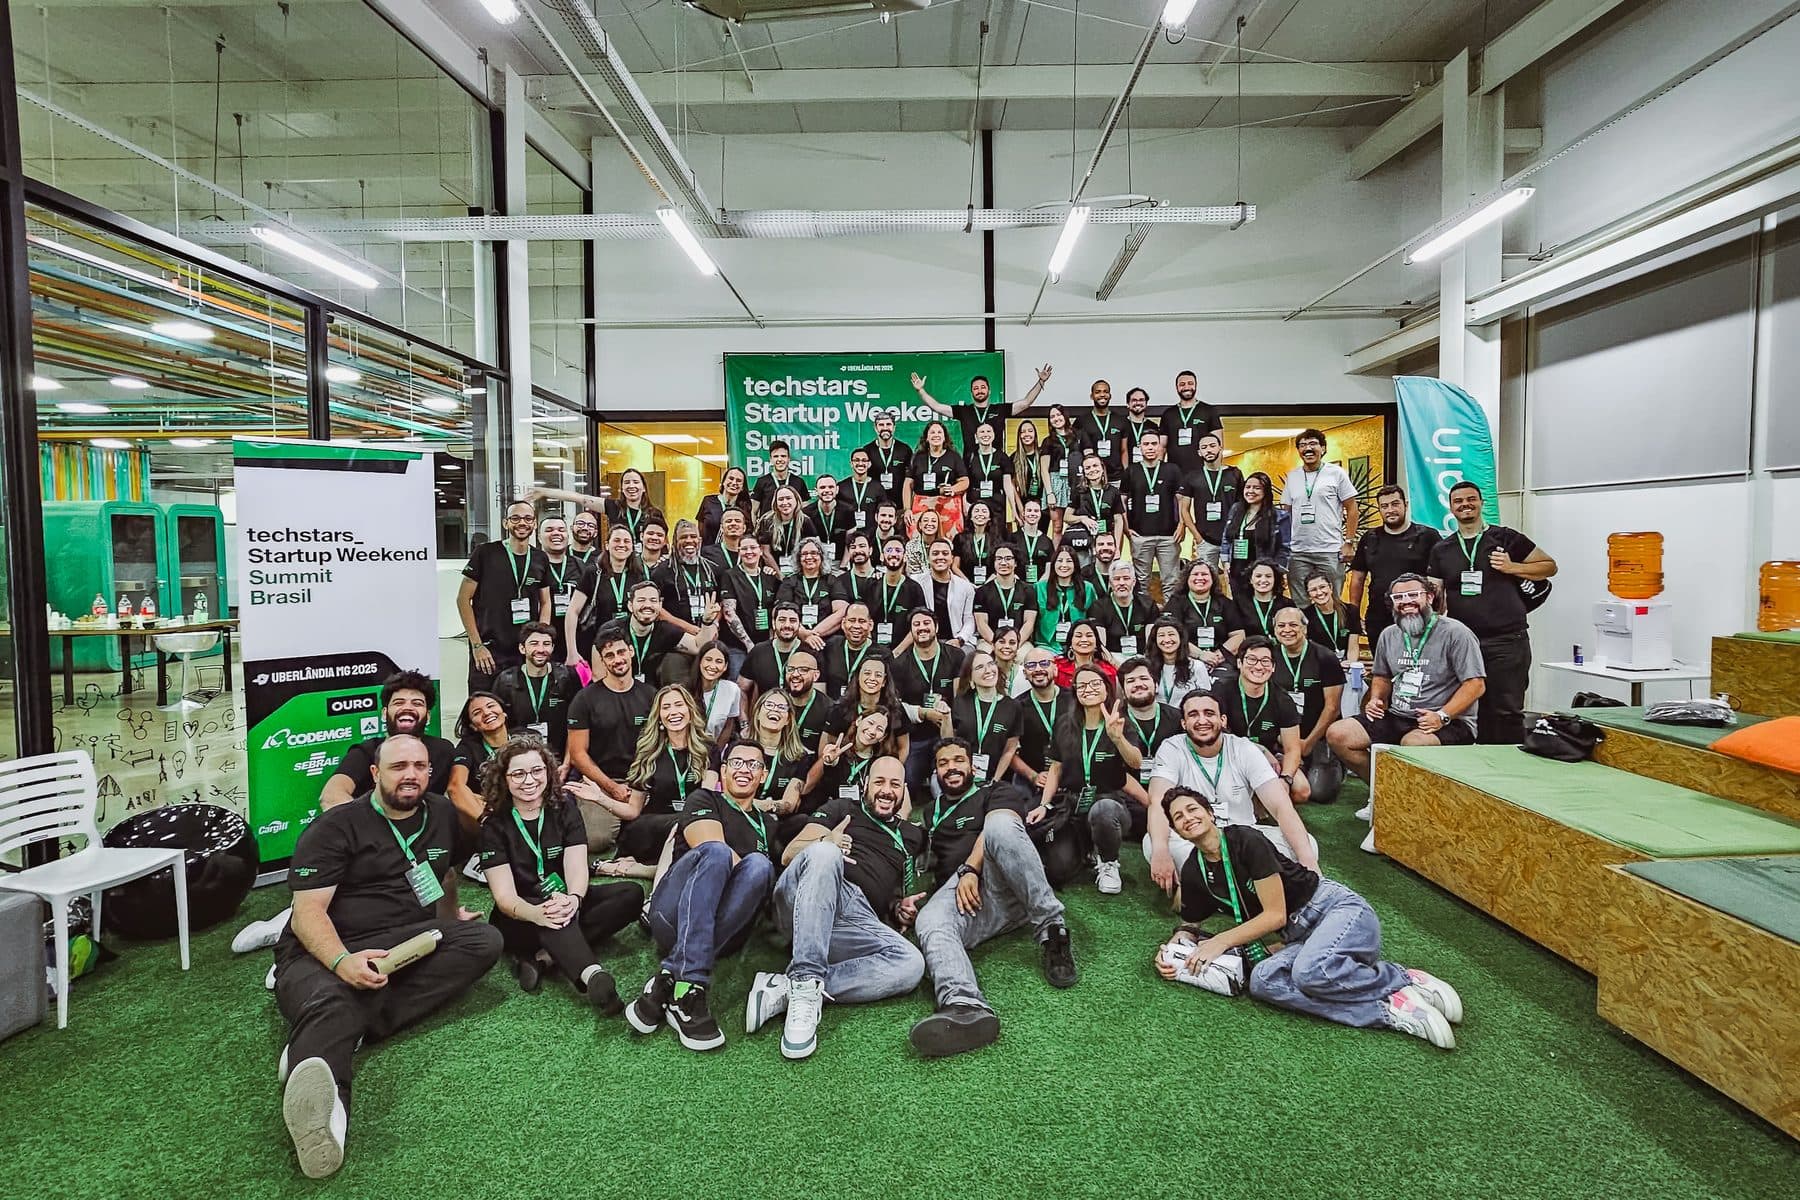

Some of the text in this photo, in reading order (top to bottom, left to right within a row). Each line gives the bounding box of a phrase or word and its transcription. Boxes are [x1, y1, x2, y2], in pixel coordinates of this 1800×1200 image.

[743, 375, 880, 399] techstars_
[744, 402, 840, 427] Startup
[746, 455, 814, 477] Brsil
[247, 527, 364, 545] techstars_
[248, 547, 428, 566] Startup Weekend
[249, 569, 333, 585] Summit
[250, 588, 312, 605] Brasil
[271, 663, 378, 684] UBERLÂNDIA MG 2025
[331, 698, 373, 712] OURO
[287, 727, 352, 746] CODEMGE
[293, 756, 340, 771] SEBRAE
[258, 820, 290, 835] Cargill
